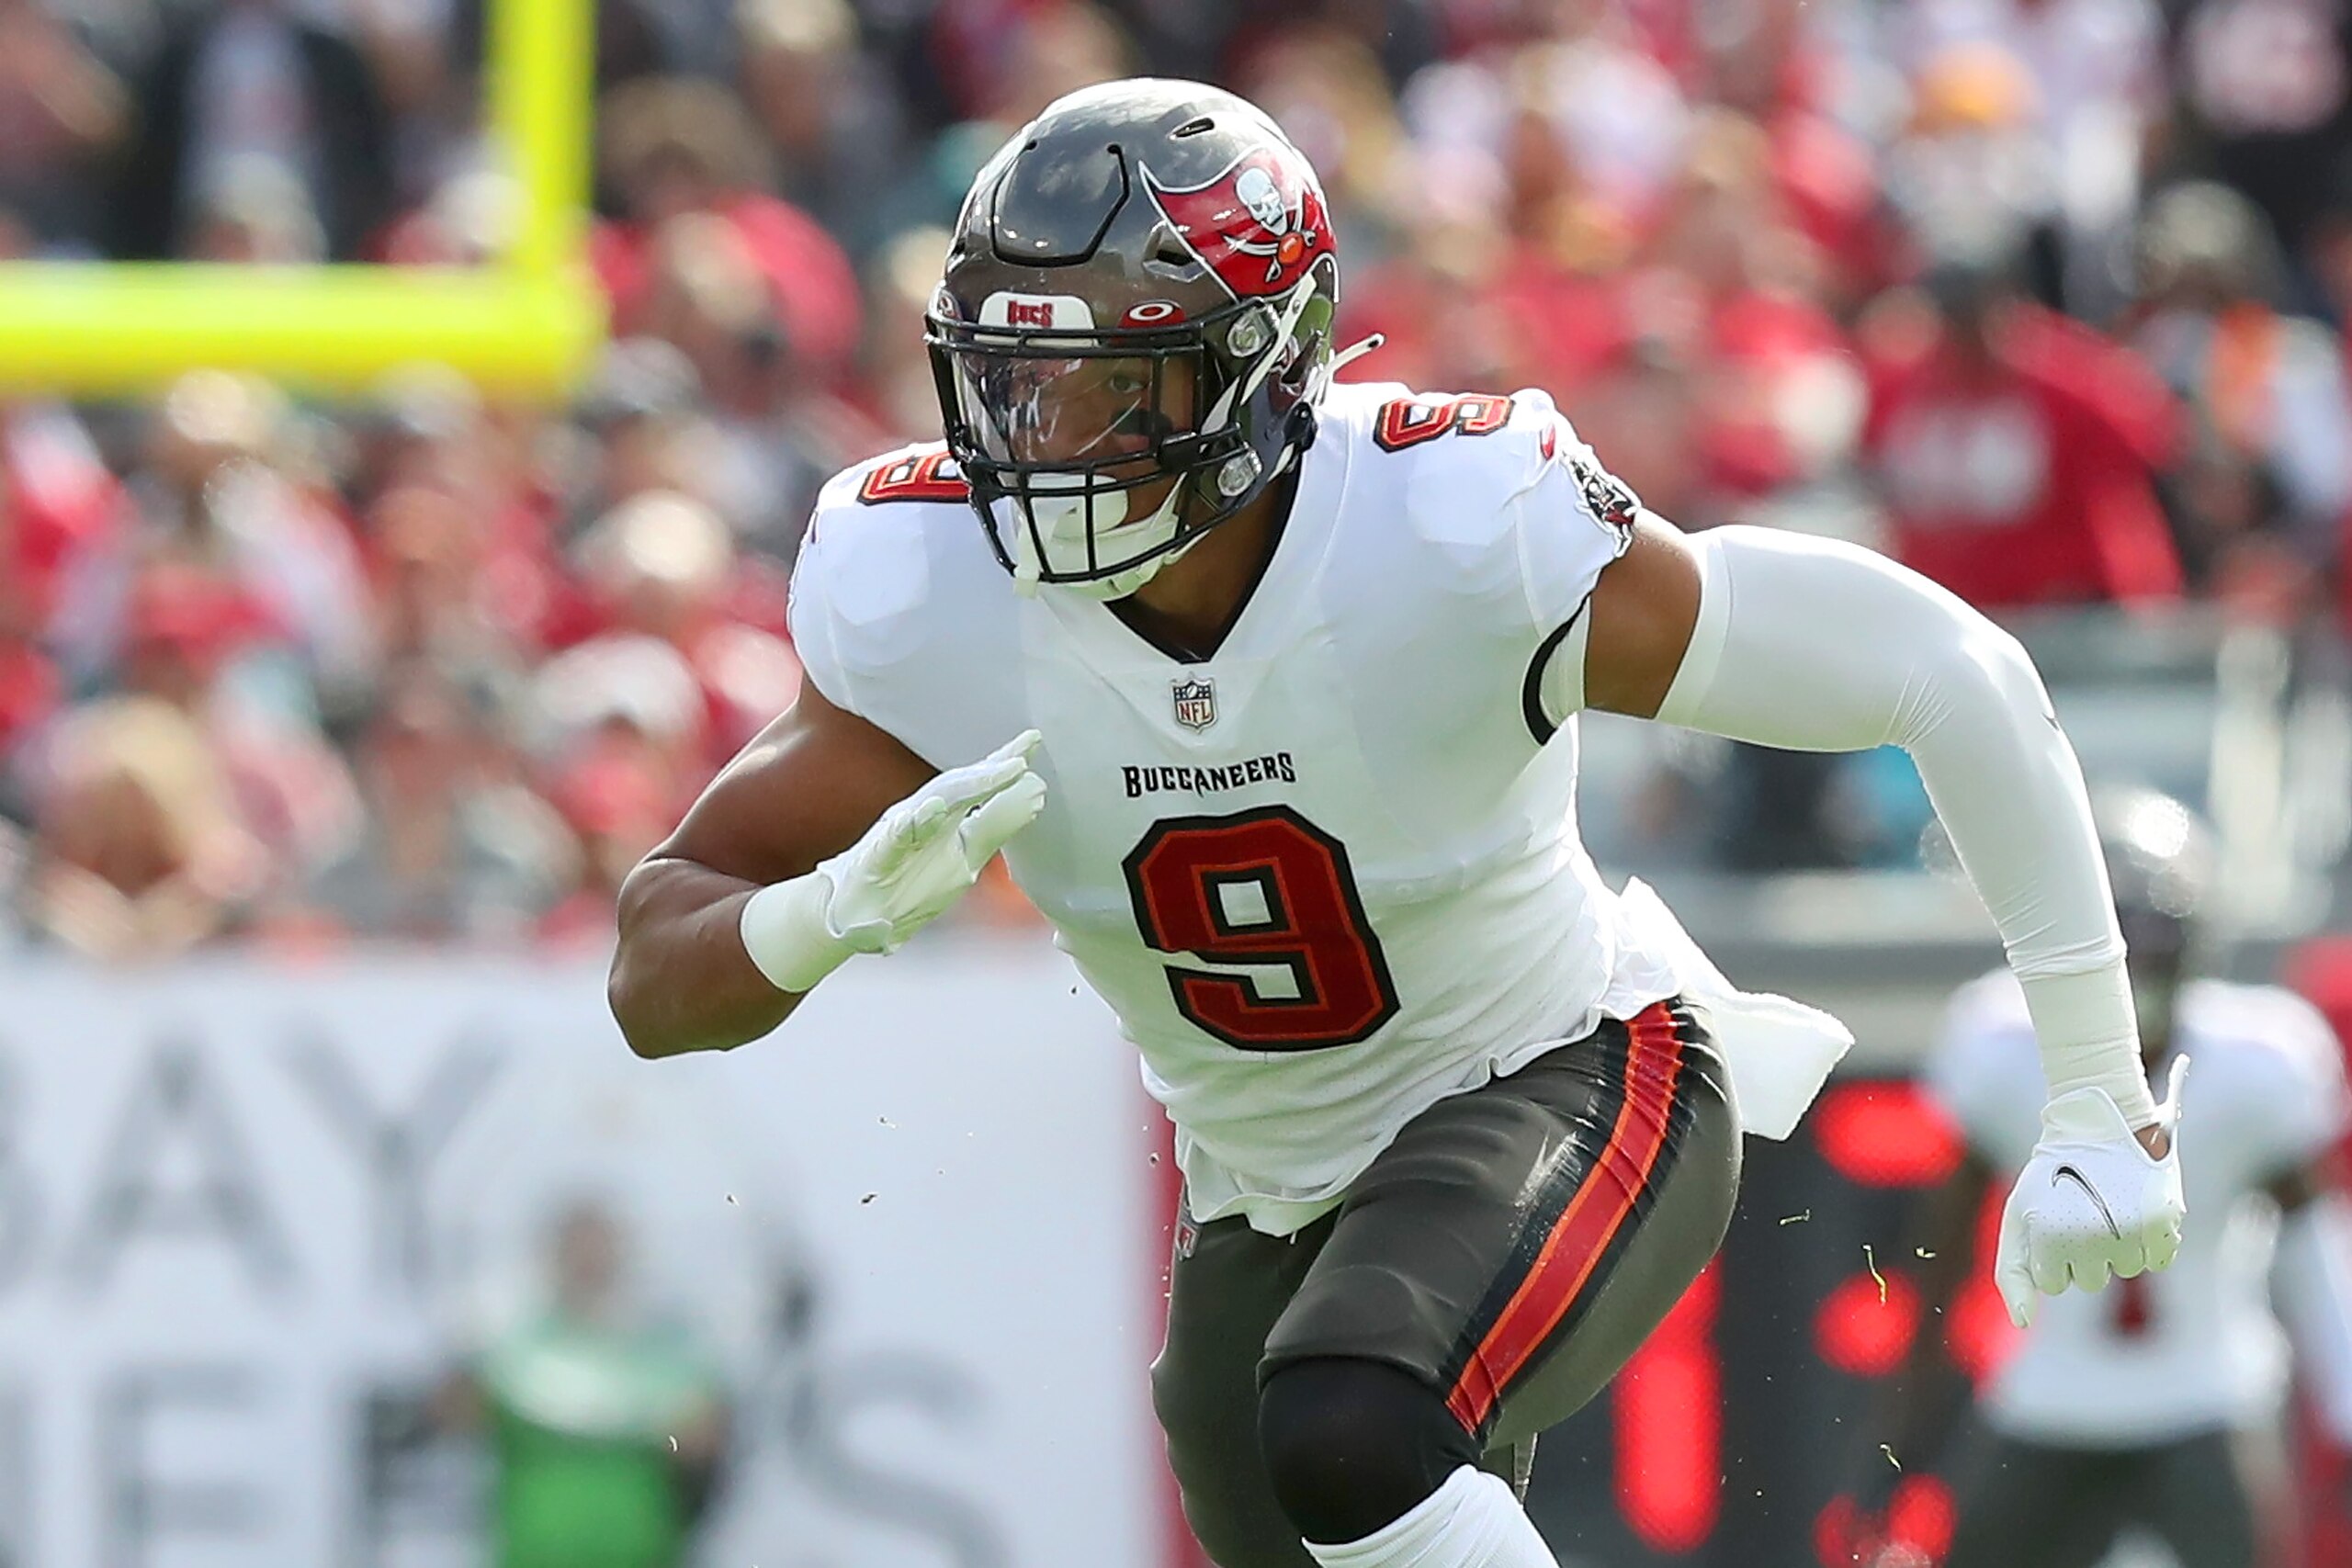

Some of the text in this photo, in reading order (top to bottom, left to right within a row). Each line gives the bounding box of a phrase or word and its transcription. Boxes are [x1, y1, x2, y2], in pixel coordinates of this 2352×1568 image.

[1374, 392, 1516, 453] 9
[1178, 700, 1211, 722] NFL
[1121, 752, 1296, 798] BUCCANEERS
[1121, 804, 1402, 1053] 9
[0, 1013, 516, 1315] AY
